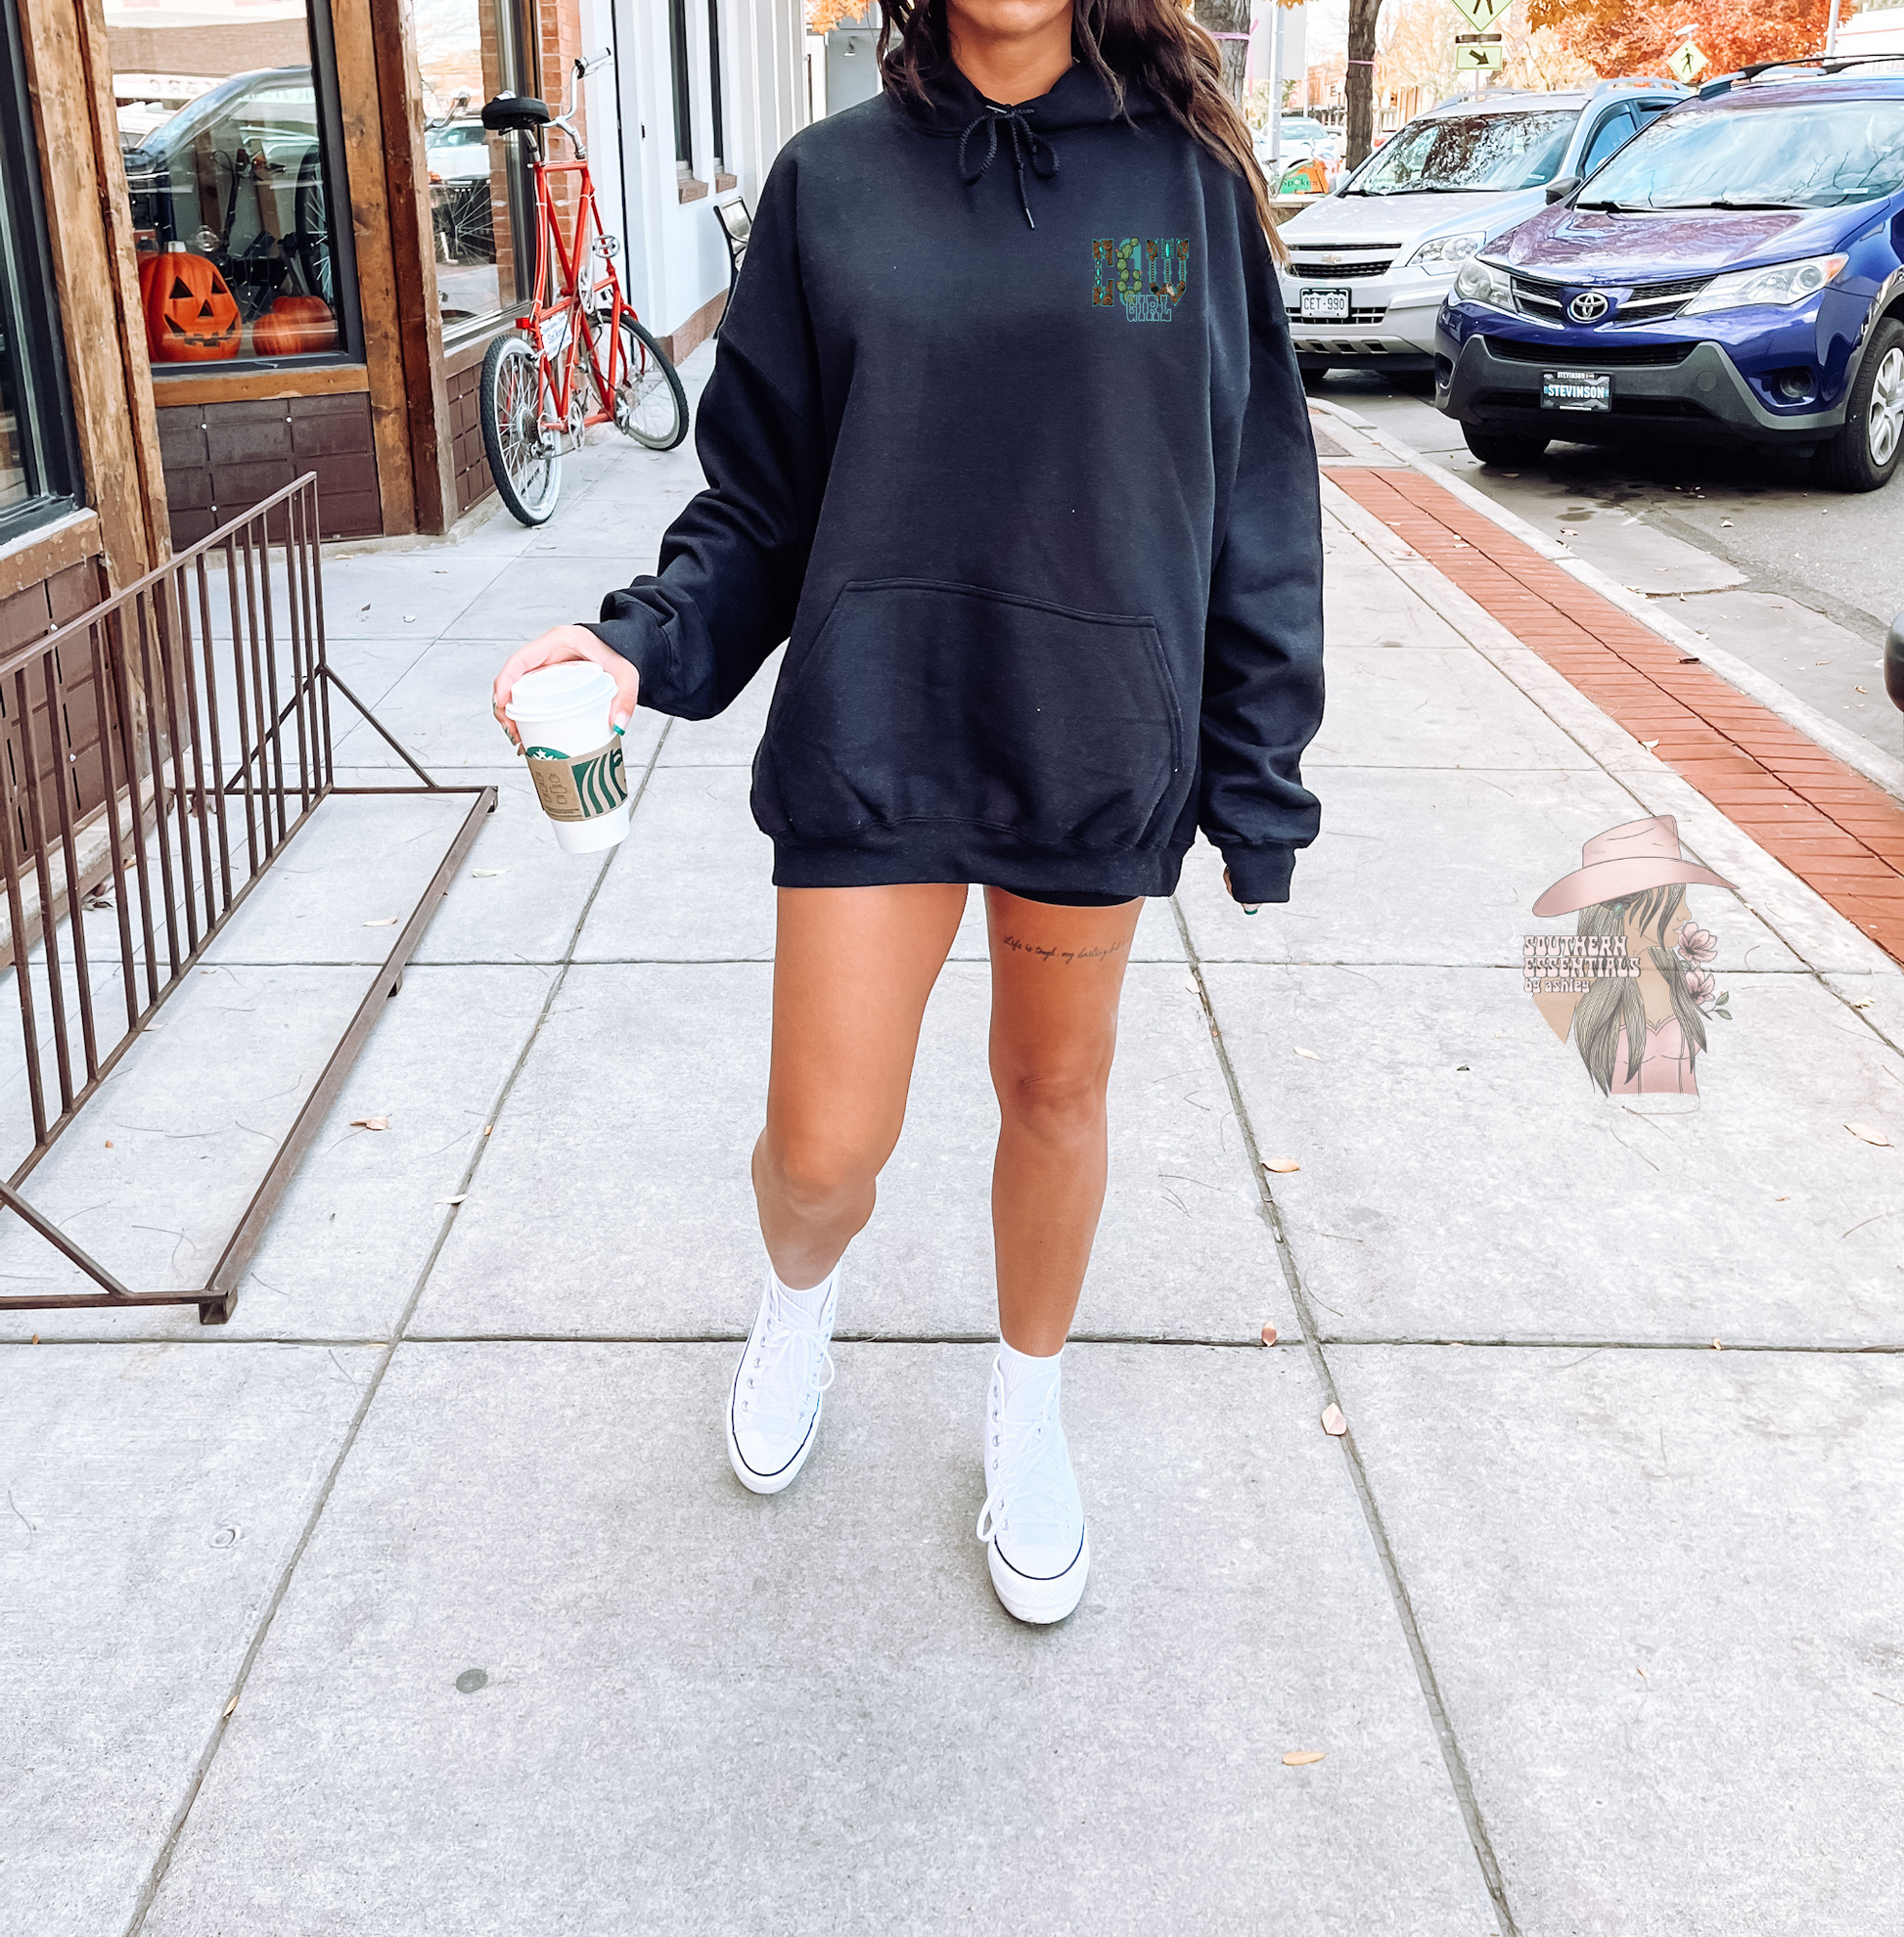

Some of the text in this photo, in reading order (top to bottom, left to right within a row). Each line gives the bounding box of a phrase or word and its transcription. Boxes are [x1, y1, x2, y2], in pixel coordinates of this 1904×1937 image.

[1283, 177, 1319, 187] Spokes
[1092, 237, 1189, 306] COW
[1126, 293, 1172, 323] GIRL
[1303, 296, 1345, 310] CET-990
[1548, 383, 1605, 399] STEVINSON
[1003, 935, 1022, 951] Life
[1062, 952, 1074, 965] my
